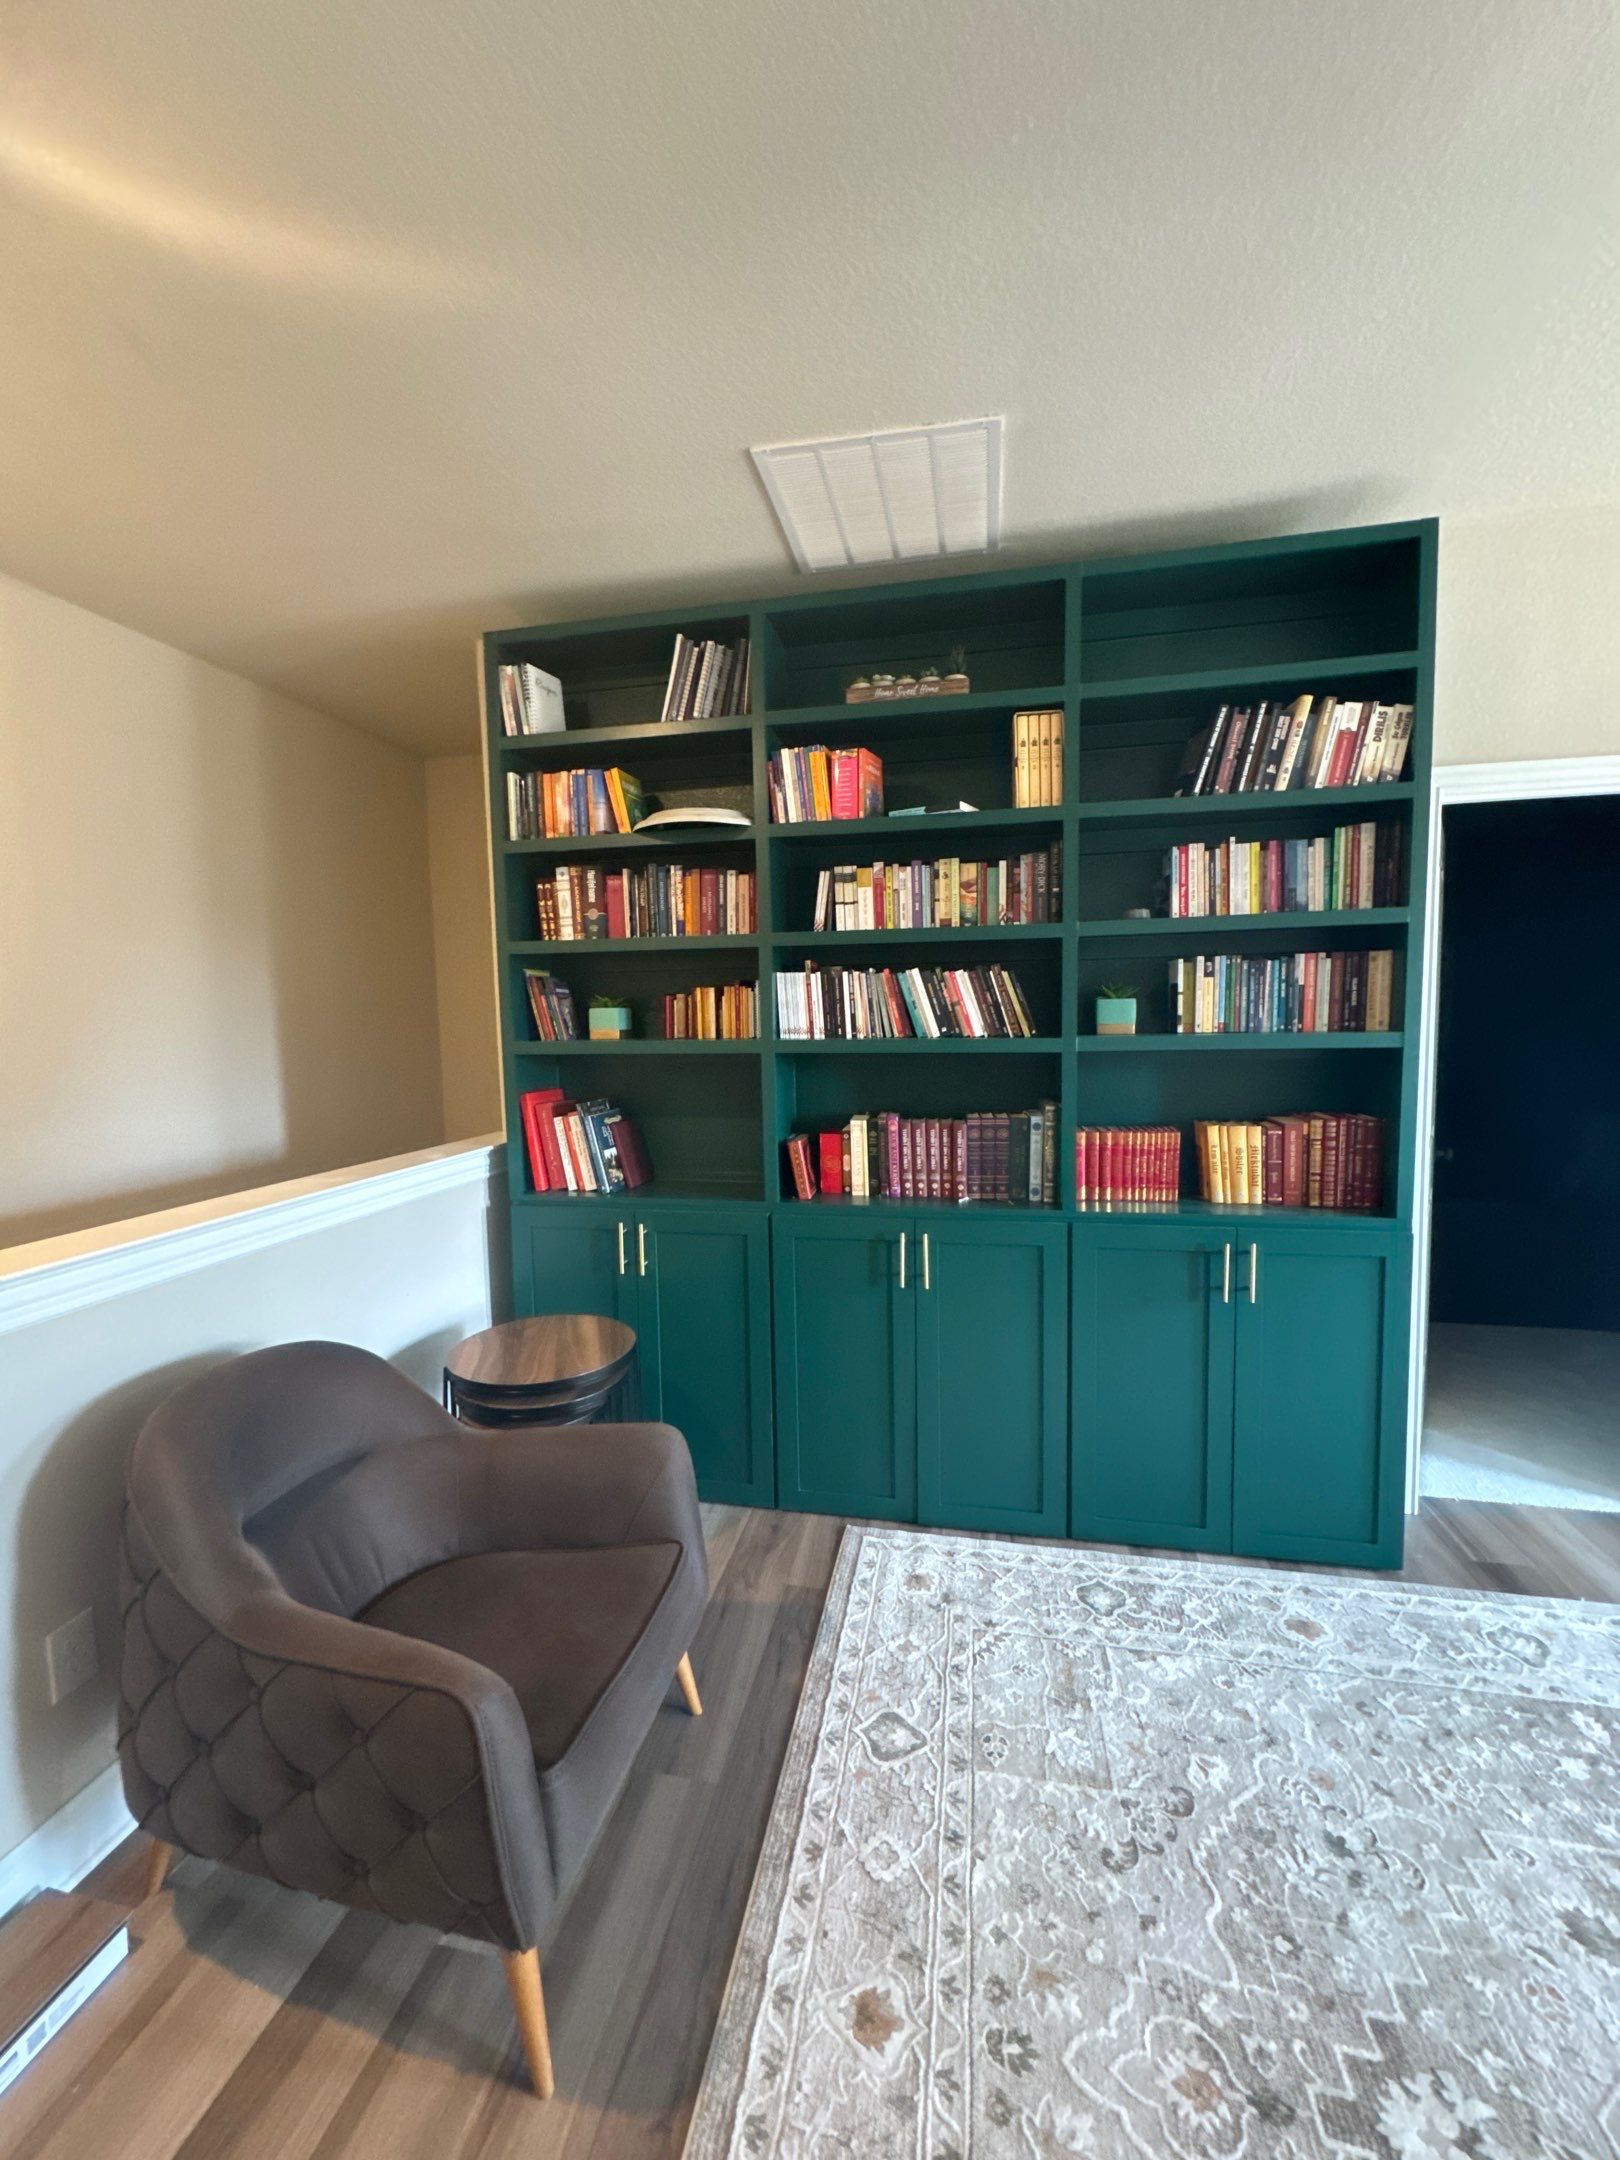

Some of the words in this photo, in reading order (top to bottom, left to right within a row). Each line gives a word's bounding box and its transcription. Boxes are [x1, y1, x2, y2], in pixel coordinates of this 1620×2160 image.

[875, 688, 895, 697] Home
[897, 685, 918, 697] Sweet
[920, 684, 939, 696] Home
[1037, 876, 1046, 893] DICK
